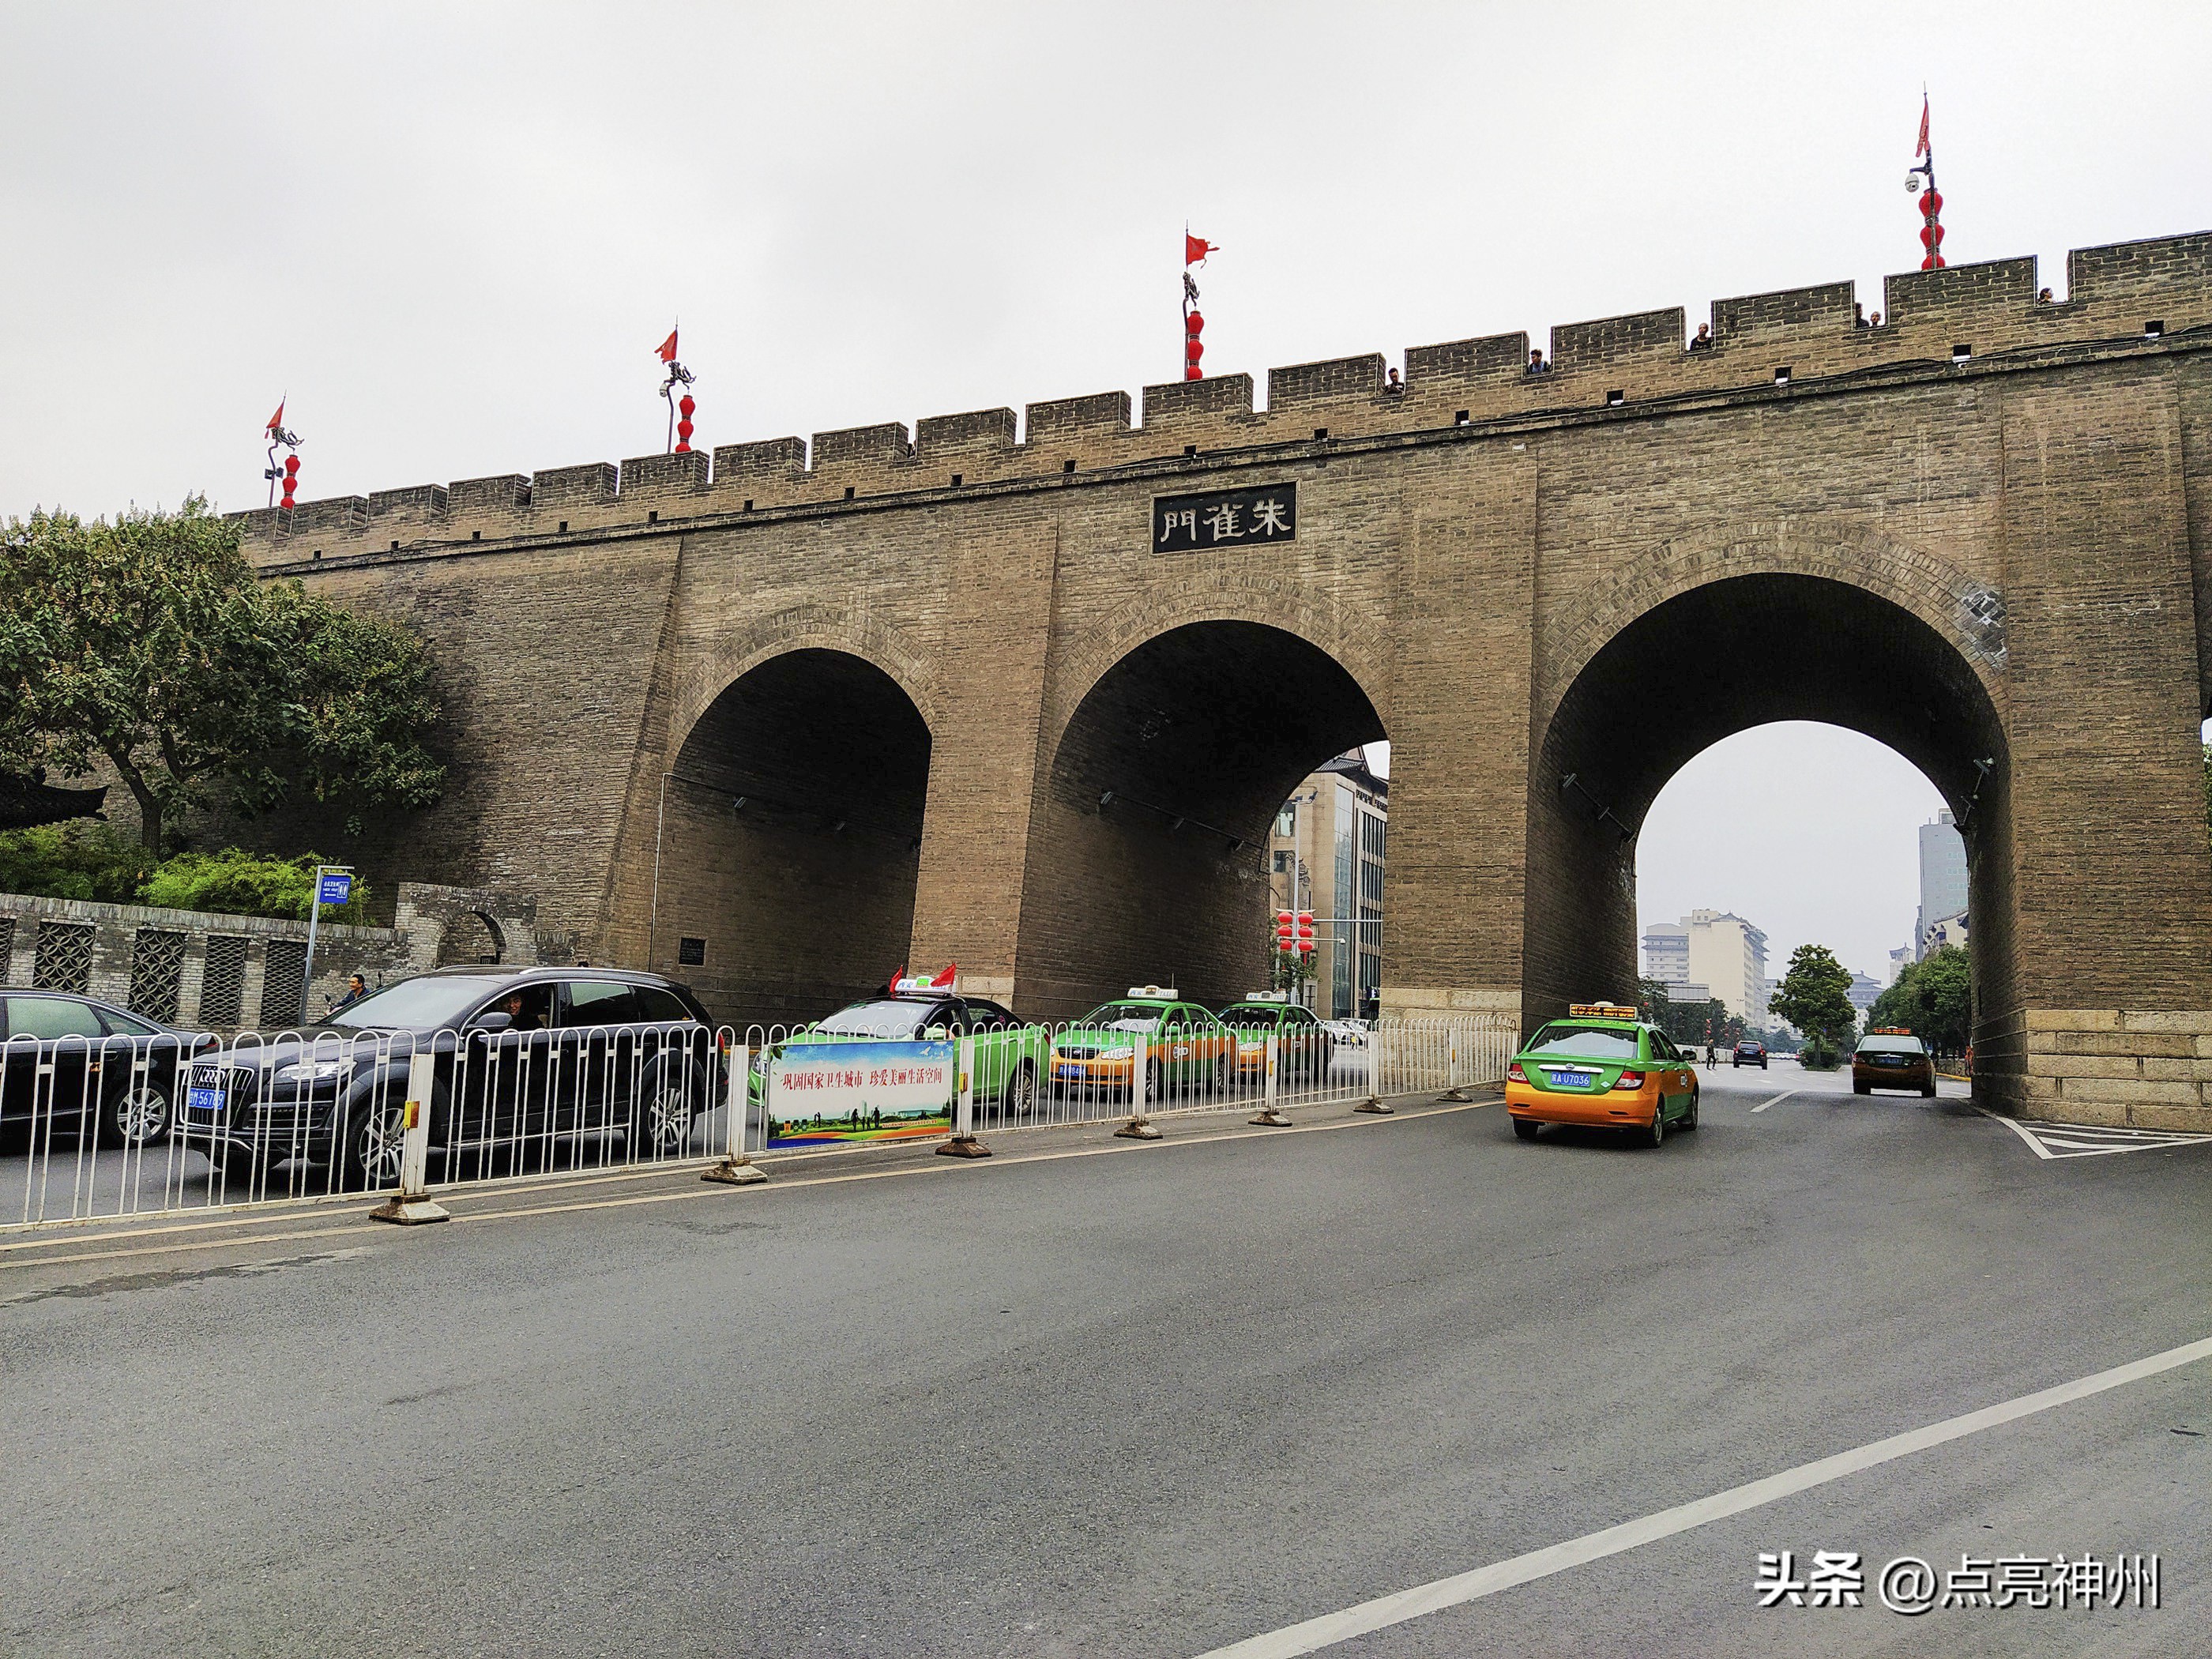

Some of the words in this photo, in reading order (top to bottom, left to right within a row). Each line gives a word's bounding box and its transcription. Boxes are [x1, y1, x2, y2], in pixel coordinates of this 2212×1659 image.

[782, 1070, 863, 1091] 巩固国家卫生城市
[869, 1067, 942, 1087] 珍爱美丽生活空间
